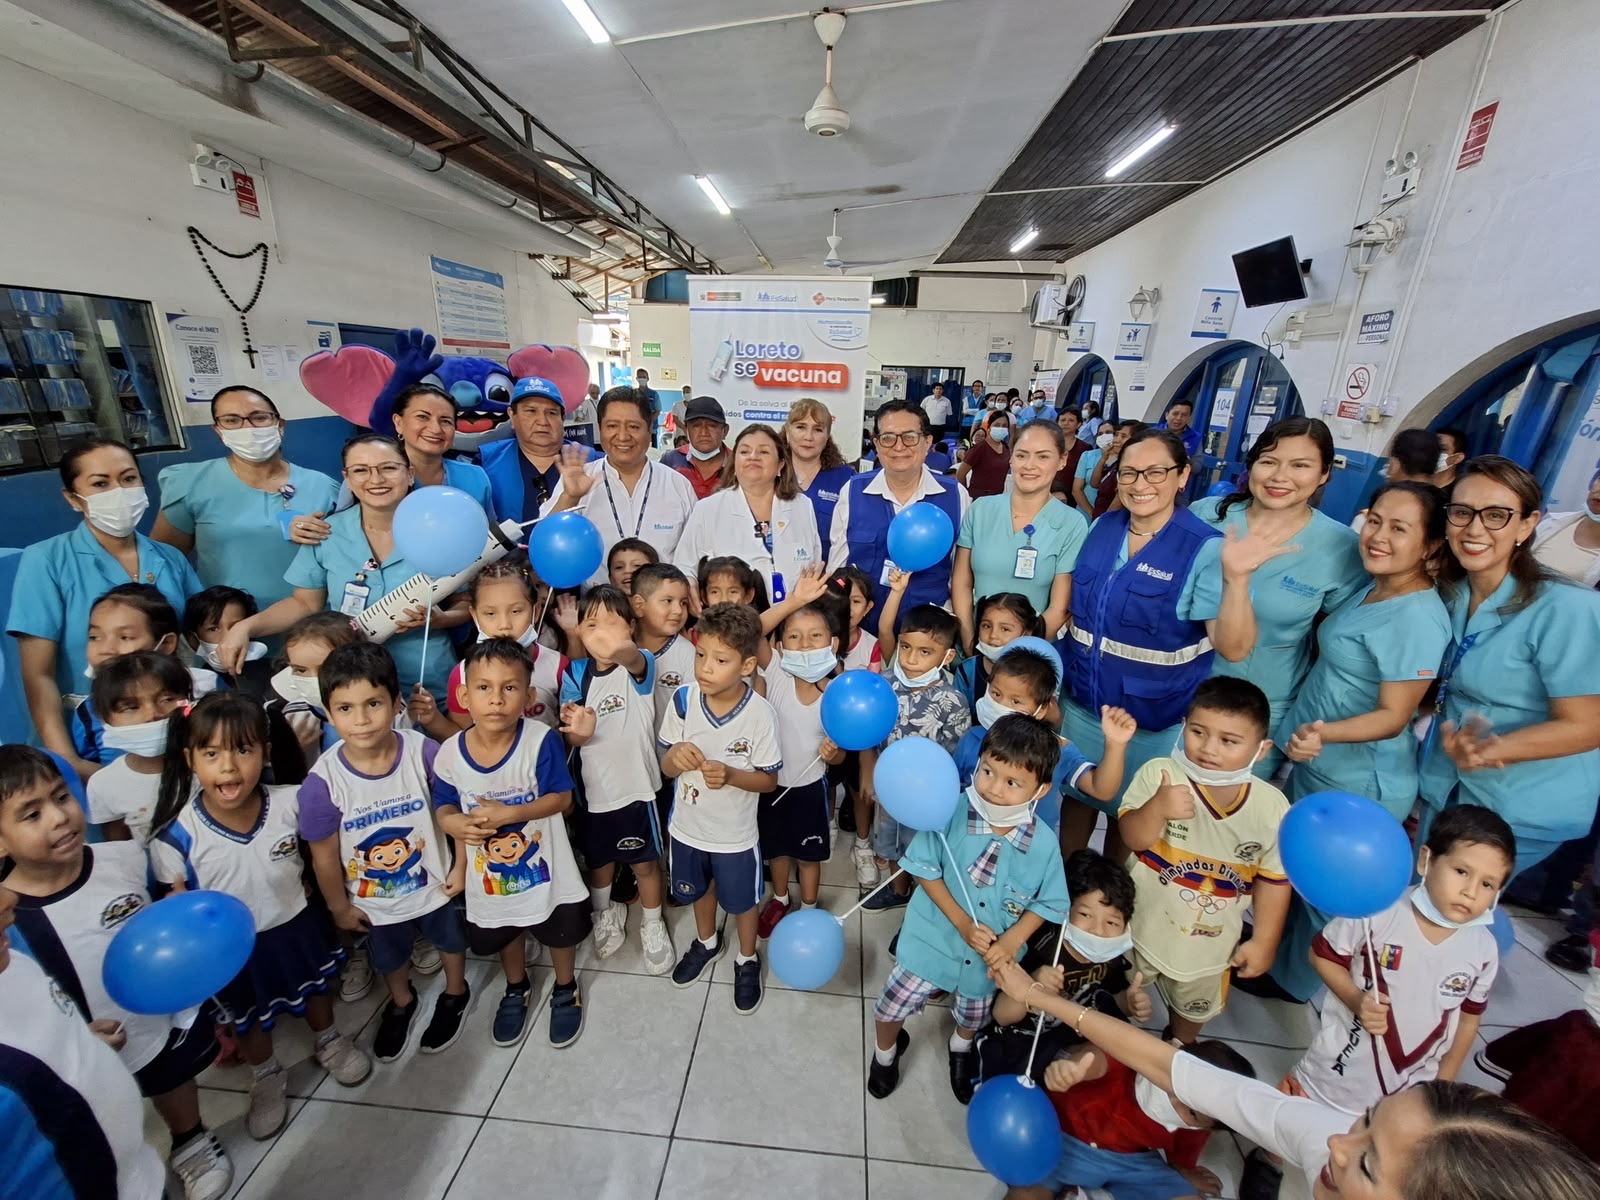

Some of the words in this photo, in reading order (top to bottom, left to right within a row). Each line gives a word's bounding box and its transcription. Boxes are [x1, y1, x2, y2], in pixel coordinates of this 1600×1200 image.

[1366, 313, 1389, 323] AFORO
[175, 324, 198, 332] Conoce
[1361, 323, 1390, 333] MÁXIMO
[736, 340, 800, 358] Loreto
[735, 361, 757, 376] se
[761, 368, 842, 384] vacuna
[1215, 398, 1231, 410] 104
[1149, 567, 1174, 579] EsSalud
[353, 804, 372, 815] Nos
[374, 796, 404, 807] Vamos
[343, 799, 424, 832] PRIMERO
[1158, 859, 1214, 886] Olimpiadas
